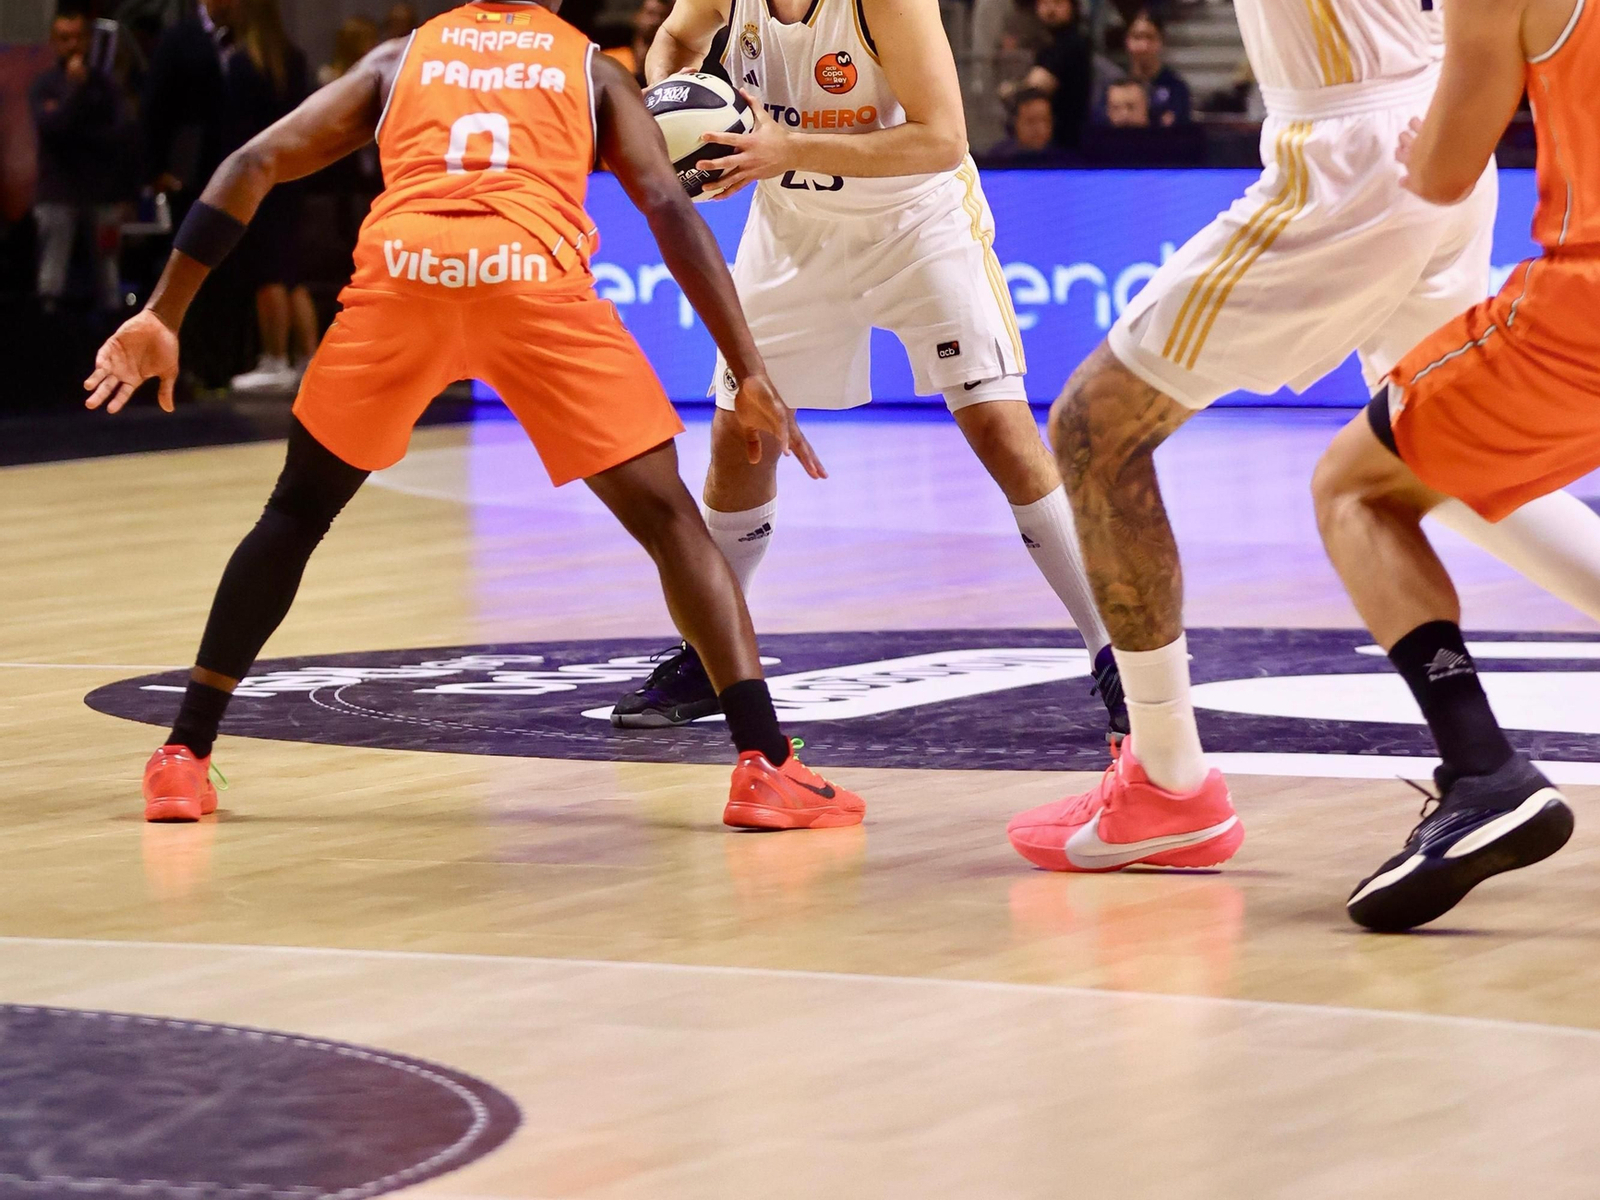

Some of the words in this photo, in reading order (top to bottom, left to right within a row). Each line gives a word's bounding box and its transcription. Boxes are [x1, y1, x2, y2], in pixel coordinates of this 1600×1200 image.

[441, 27, 555, 53] HARPER
[764, 103, 877, 129] TOHERO
[383, 239, 548, 288] Vitaldin
[940, 348, 955, 357] acb
